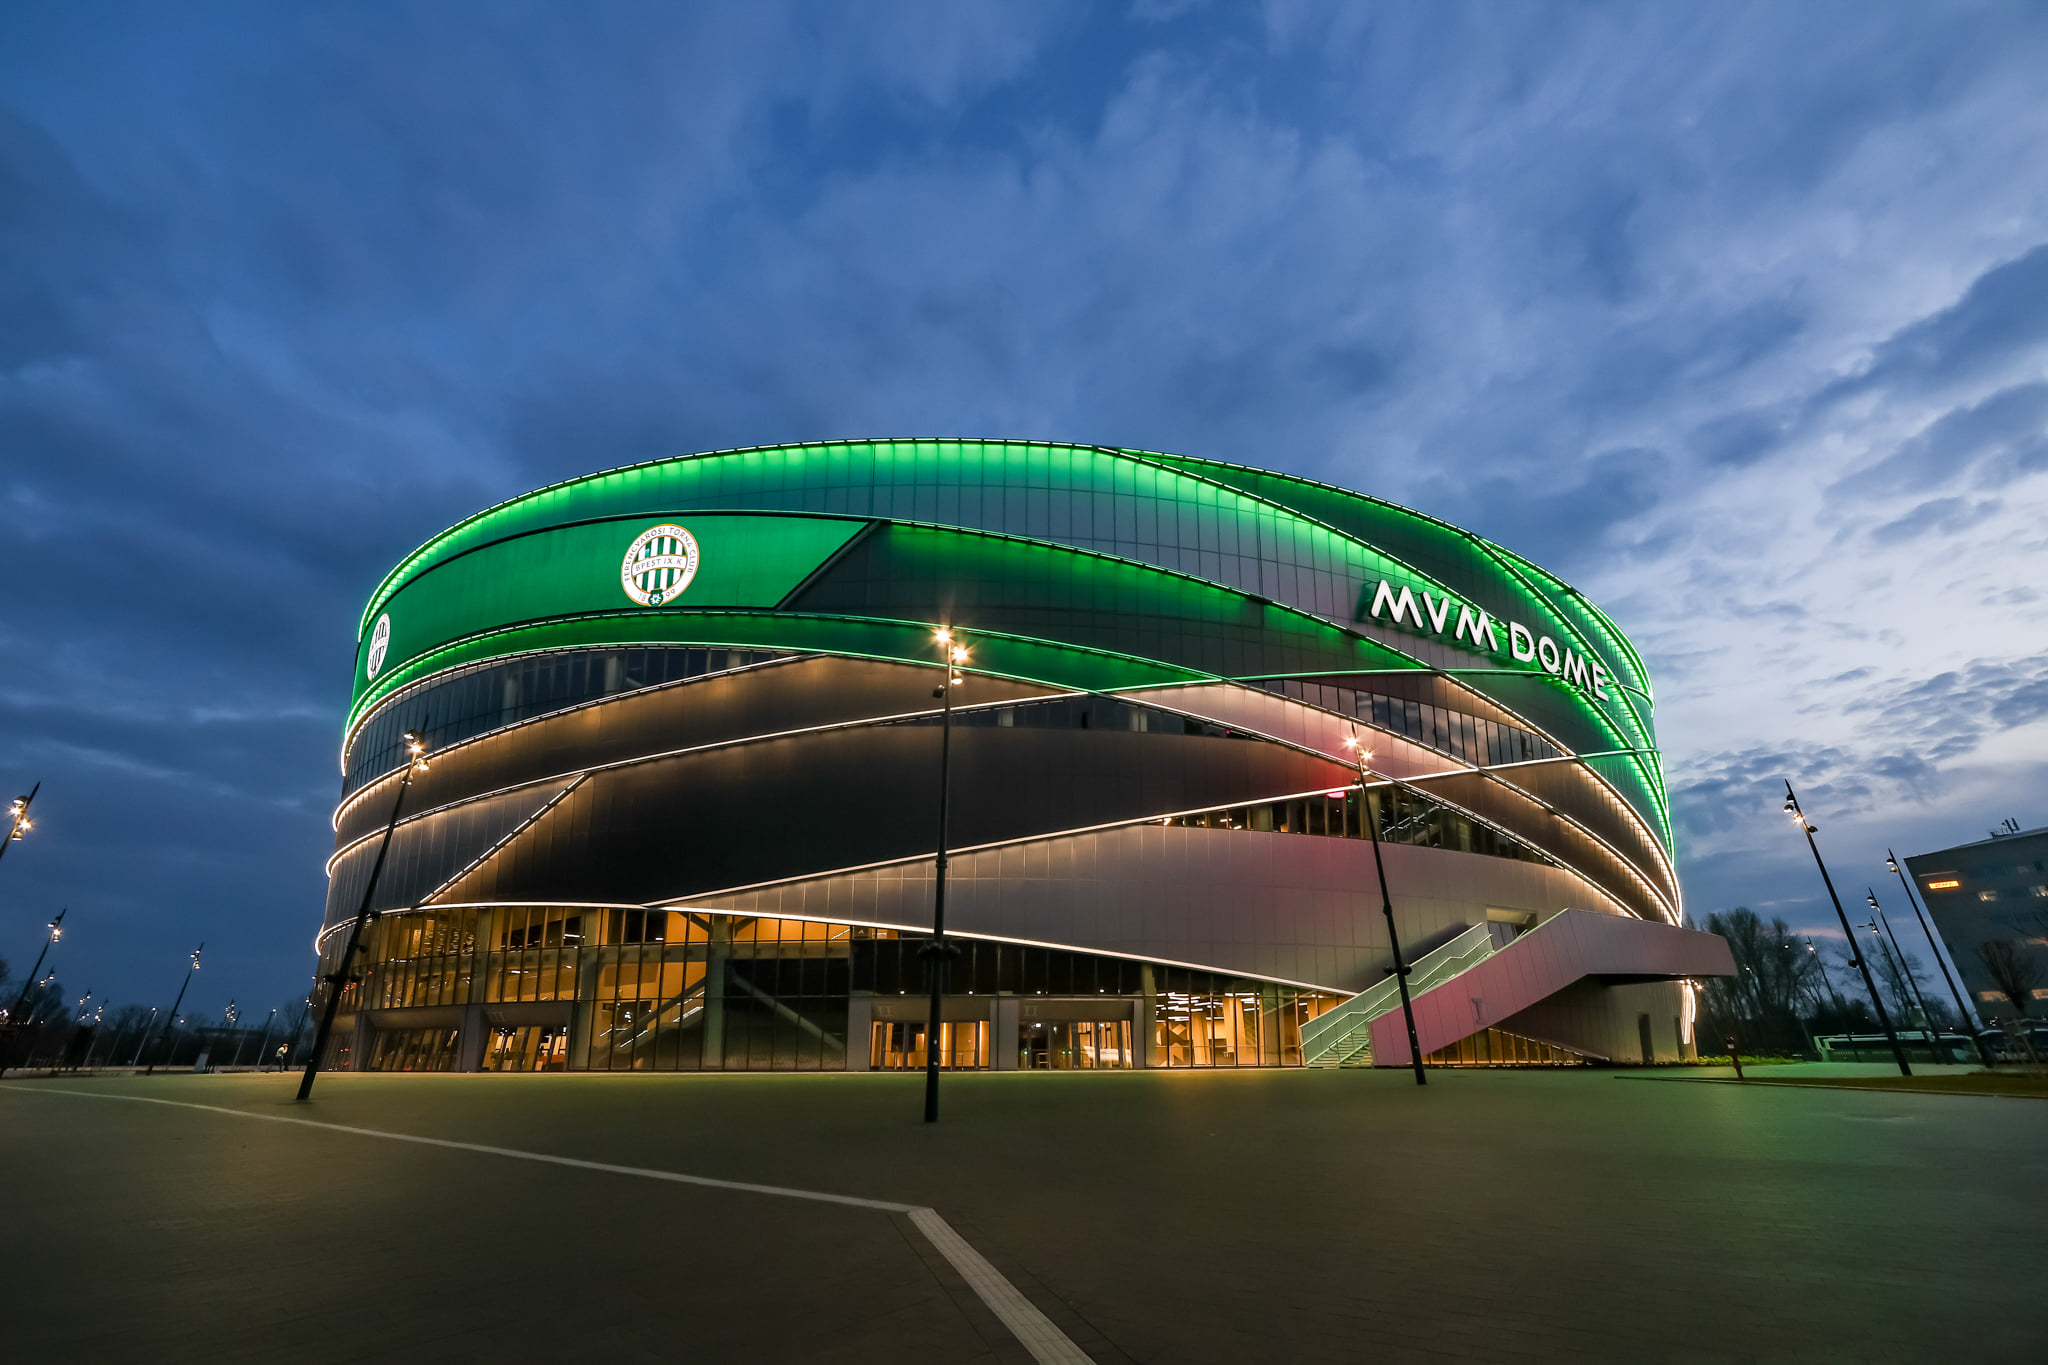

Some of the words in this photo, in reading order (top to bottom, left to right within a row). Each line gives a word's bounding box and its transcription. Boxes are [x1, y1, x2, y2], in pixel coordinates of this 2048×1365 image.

[669, 527, 693, 548] TORNA
[1370, 579, 1498, 652] MVM
[1509, 621, 1609, 701] DOME
